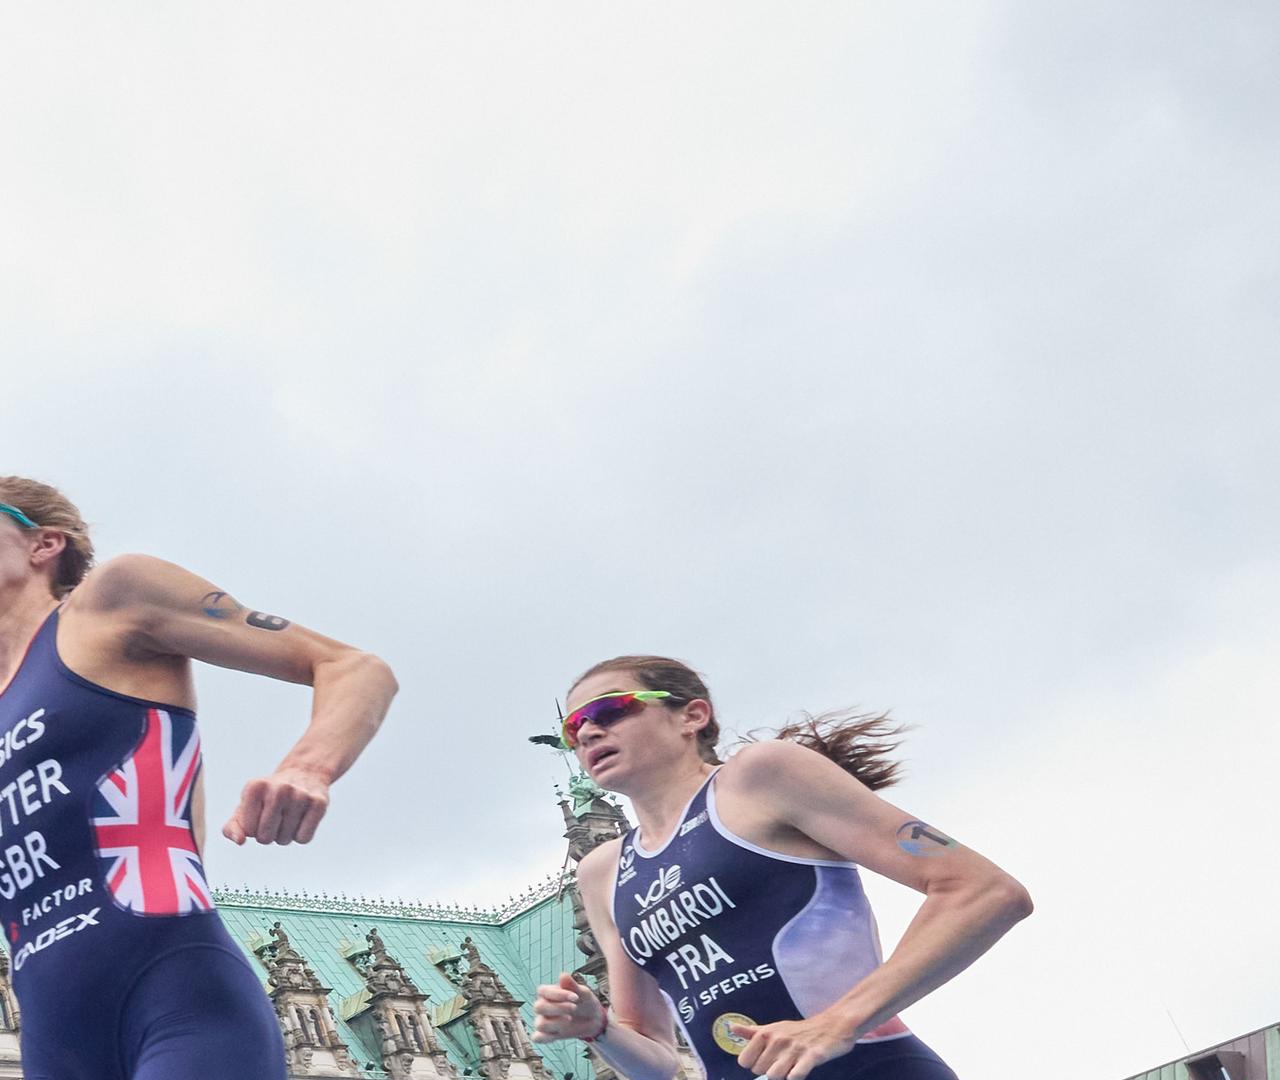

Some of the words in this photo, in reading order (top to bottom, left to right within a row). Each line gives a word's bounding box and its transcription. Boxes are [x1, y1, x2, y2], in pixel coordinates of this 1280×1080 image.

[22, 878, 94, 926] FACTOR
[621, 877, 736, 967] LOMBARDI
[665, 934, 735, 990] FRA
